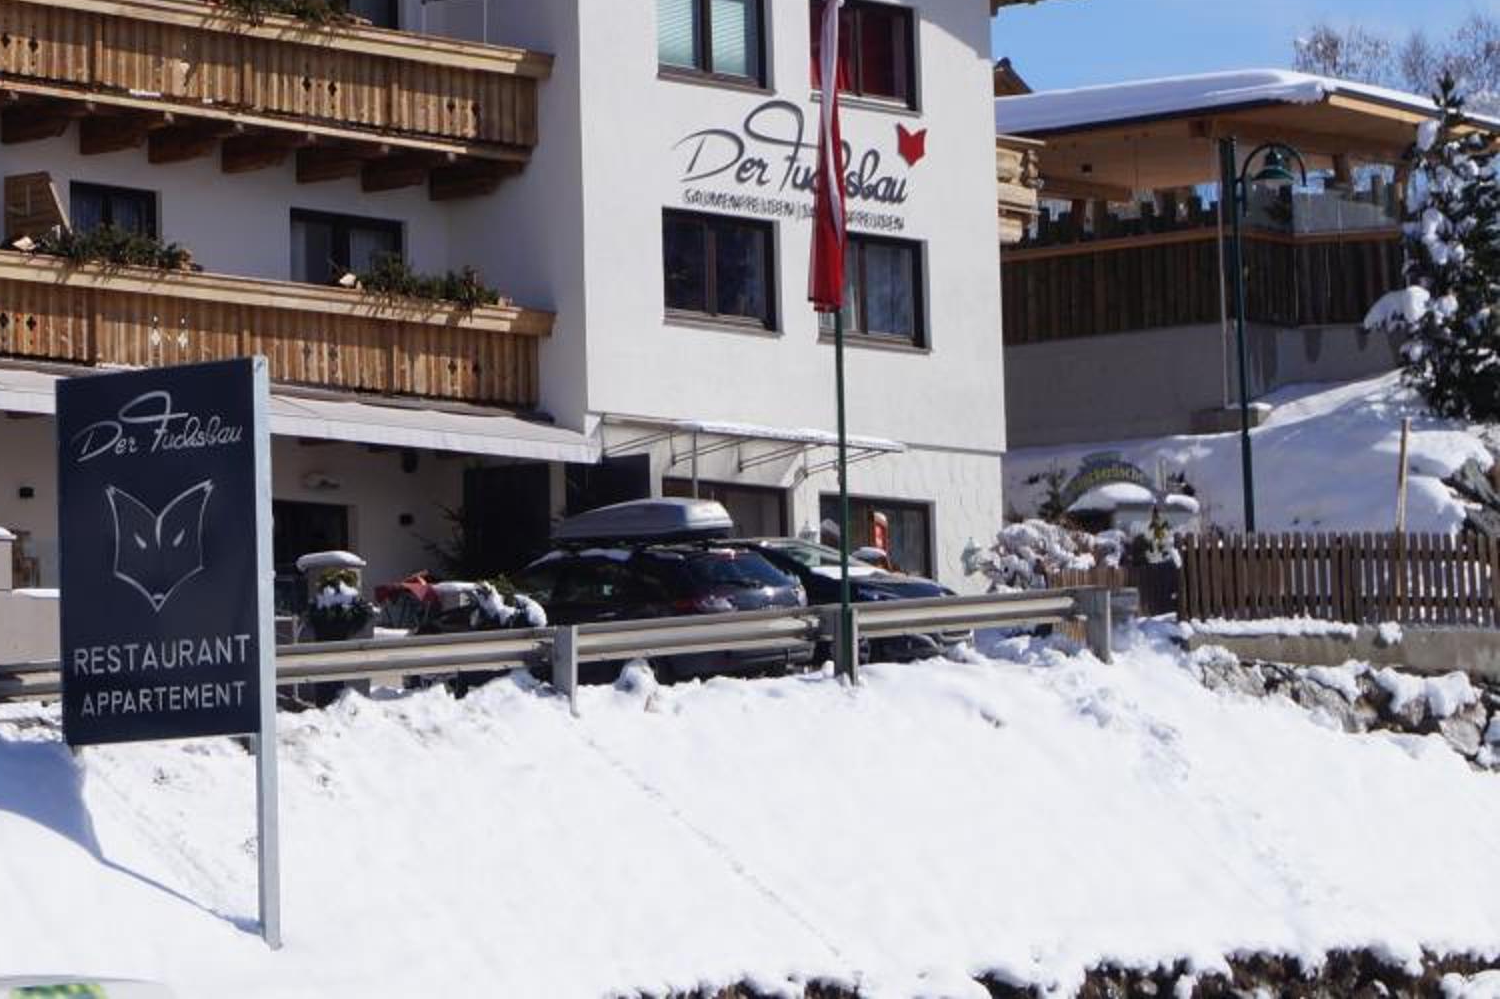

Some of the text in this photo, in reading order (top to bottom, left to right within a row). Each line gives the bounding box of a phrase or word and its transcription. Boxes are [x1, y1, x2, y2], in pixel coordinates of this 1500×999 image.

[673, 129, 769, 185] Der
[72, 391, 243, 462] Der Fuchsbau
[73, 634, 251, 676] RESTAURANT
[80, 681, 247, 718] APPARTEMENT
